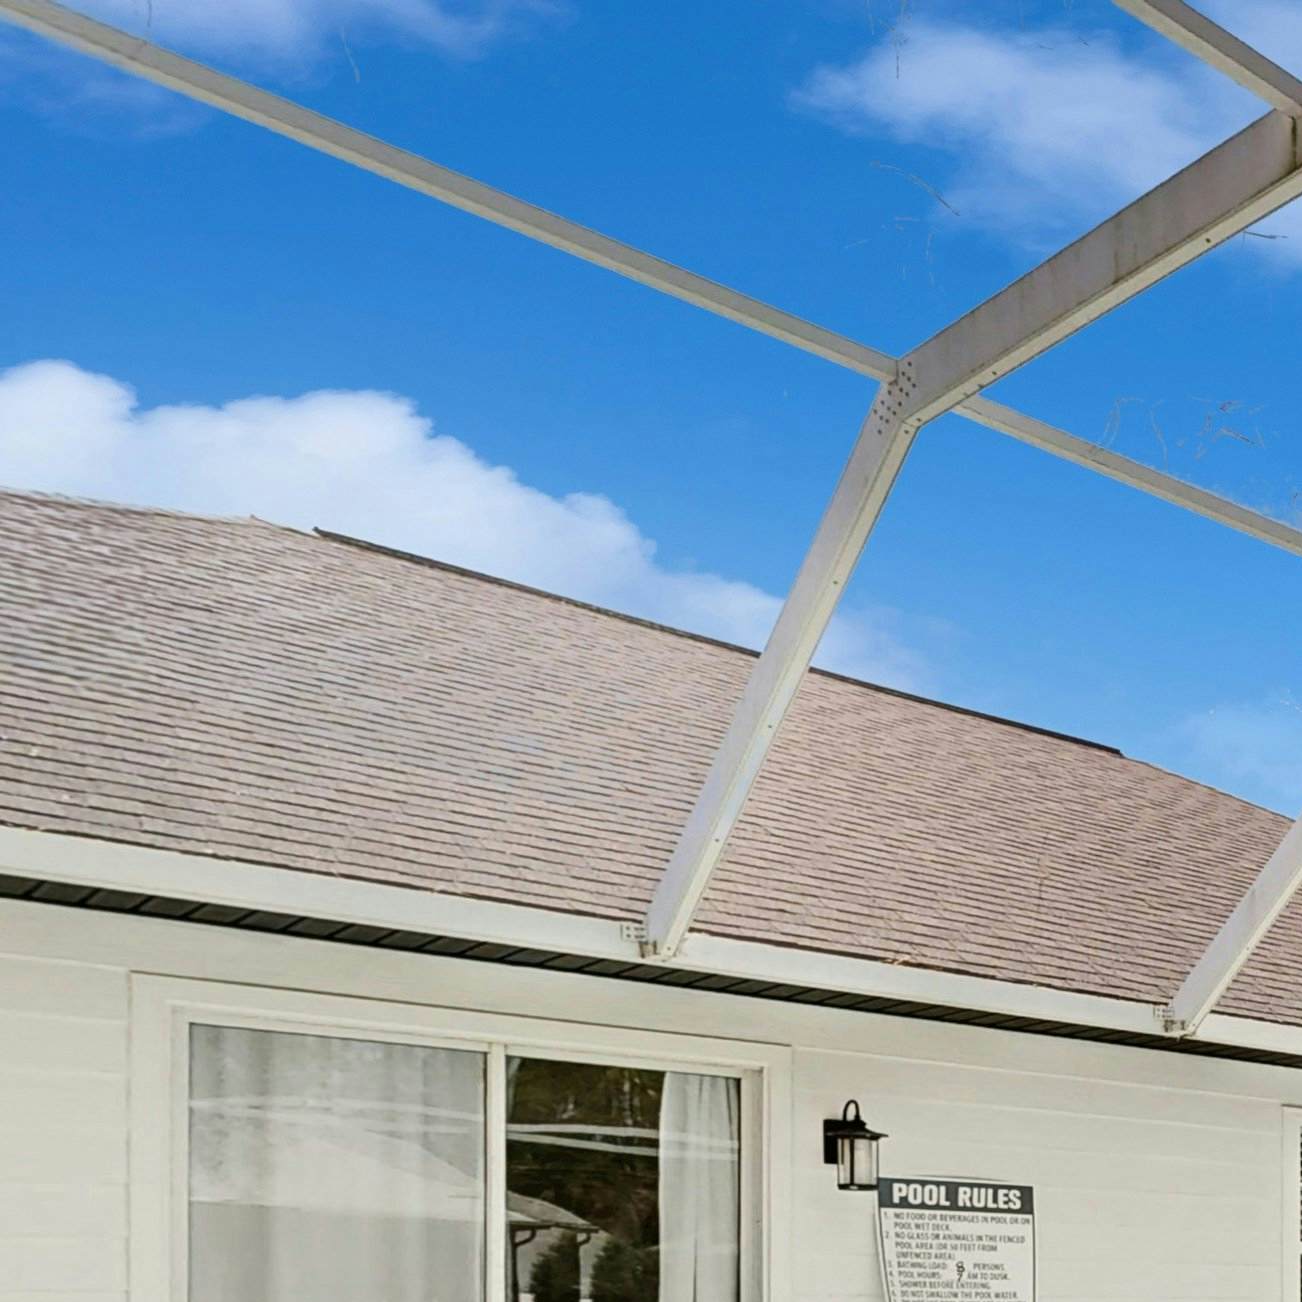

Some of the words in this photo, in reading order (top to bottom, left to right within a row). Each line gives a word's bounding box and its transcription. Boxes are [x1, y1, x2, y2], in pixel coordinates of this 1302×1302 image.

[892, 1182, 951, 1206] POOL
[957, 1186, 1022, 1210] RULES
[894, 1212, 904, 1220] NO
[939, 1214, 979, 1223] BEVERAGES
[990, 1216, 1009, 1224] POOL
[1009, 1217, 1020, 1225] OR
[1021, 1217, 1031, 1225] ON
[894, 1222, 912, 1230] POOL
[894, 1231, 905, 1239] NO
[907, 1232, 929, 1240] GLASS
[942, 1234, 974, 1242] ANIMALS
[984, 1234, 998, 1243] THE
[999, 1235, 1026, 1244] FENCED
[894, 1241, 912, 1249] POOL
[959, 1243, 977, 1251] FEET
[896, 1251, 932, 1260] UNFENCED
[897, 1260, 927, 1269] BATHING
[898, 1270, 915, 1278] POOL
[980, 1272, 989, 1280] TO
[899, 1280, 927, 1288] SHOWER
[928, 1281, 954, 1289] BEFORE
[900, 1290, 910, 1298] DO
[910, 1290, 924, 1298] NOT
[925, 1290, 959, 1299] SWALLOW
[960, 1291, 973, 1299] THE
[974, 1291, 992, 1299] POOL
